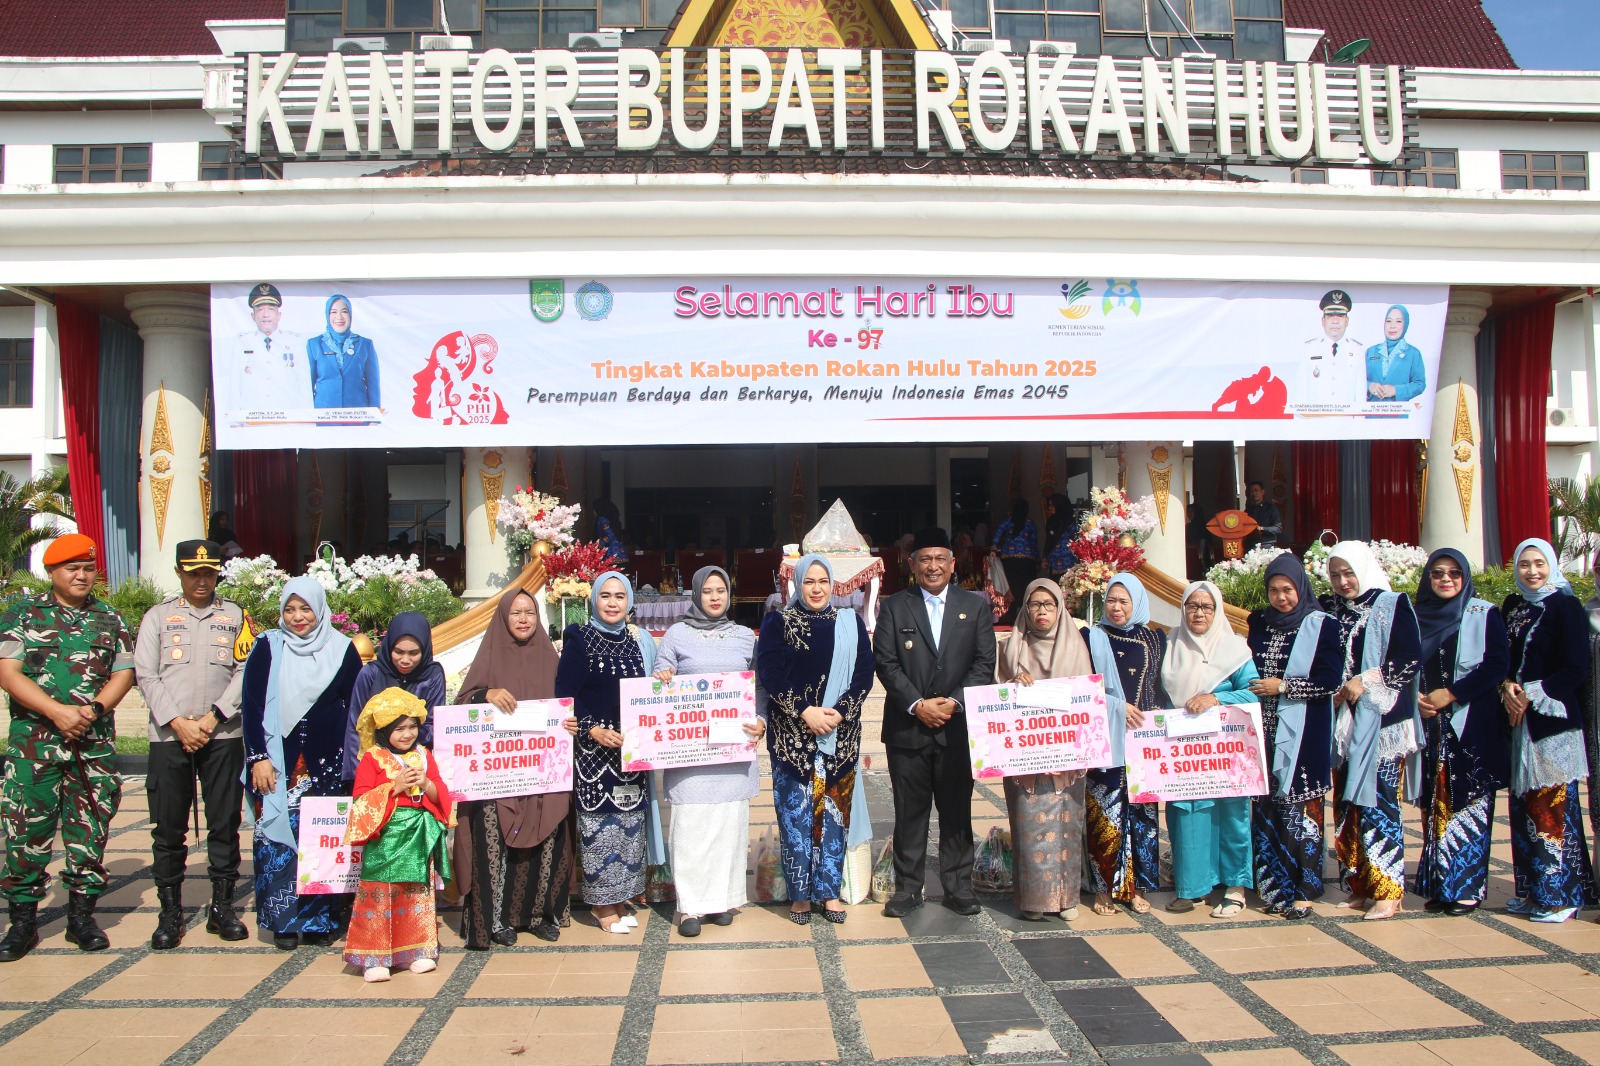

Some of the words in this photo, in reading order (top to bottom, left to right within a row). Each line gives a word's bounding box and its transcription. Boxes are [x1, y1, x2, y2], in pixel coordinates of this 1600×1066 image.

[245, 48, 585, 157] KANTOR
[617, 48, 884, 151] BUPATI
[914, 50, 1190, 157] ROKAN
[1213, 60, 1402, 162] HULU
[674, 284, 844, 317] Selamat
[856, 283, 937, 317] Hari
[946, 284, 1015, 317] Ibu
[808, 329, 837, 347] Ke
[857, 327, 884, 350] 97
[591, 360, 683, 382] Tingkat
[690, 360, 818, 381] Kabupaten
[827, 360, 900, 377] Rokan
[908, 360, 960, 377] Hulu
[967, 360, 1038, 377] Tahun
[1045, 360, 1097, 377] 2025
[527, 387, 617, 406] Perempuan
[627, 386, 690, 405] Berdaya
[700, 386, 728, 400] dan
[738, 386, 812, 405] Berkarya,
[823, 385, 882, 402] Menuju
[893, 385, 964, 400] Indonesia
[974, 385, 1014, 400] Emas
[1022, 385, 1069, 399] 2045
[467, 404, 491, 414] PHI
[468, 415, 489, 423] 2025
[631, 697, 663, 706] APRESIASI
[682, 693, 712, 702] KELUARGA
[715, 691, 741, 699] INOVATIF
[978, 703, 1010, 712] APRESIASI
[1022, 708, 1054, 716] SEBESAR
[639, 715, 661, 727] Rp.
[666, 708, 738, 725] 3.000.000
[988, 722, 1010, 734] Rp.
[1015, 712, 1090, 731] 3.000.000
[446, 724, 479, 734] APRESIASI
[654, 730, 662, 742] &
[668, 726, 709, 741] SOVEN
[1134, 730, 1166, 738] APRESIASI
[454, 744, 476, 757] Rp.
[482, 736, 556, 754] 3.000.000
[1004, 736, 1013, 748] &
[1019, 730, 1076, 747] SOVENIR
[1143, 747, 1166, 760] Rp.
[1170, 741, 1244, 758] 3.000.000
[470, 760, 478, 772] &
[484, 754, 541, 770] SOVENIR
[1160, 763, 1168, 774] &
[1174, 758, 1231, 773] SOVENIR
[312, 817, 347, 825] APRESIASI
[320, 835, 344, 848] Rp.
[336, 852, 345, 863] &
